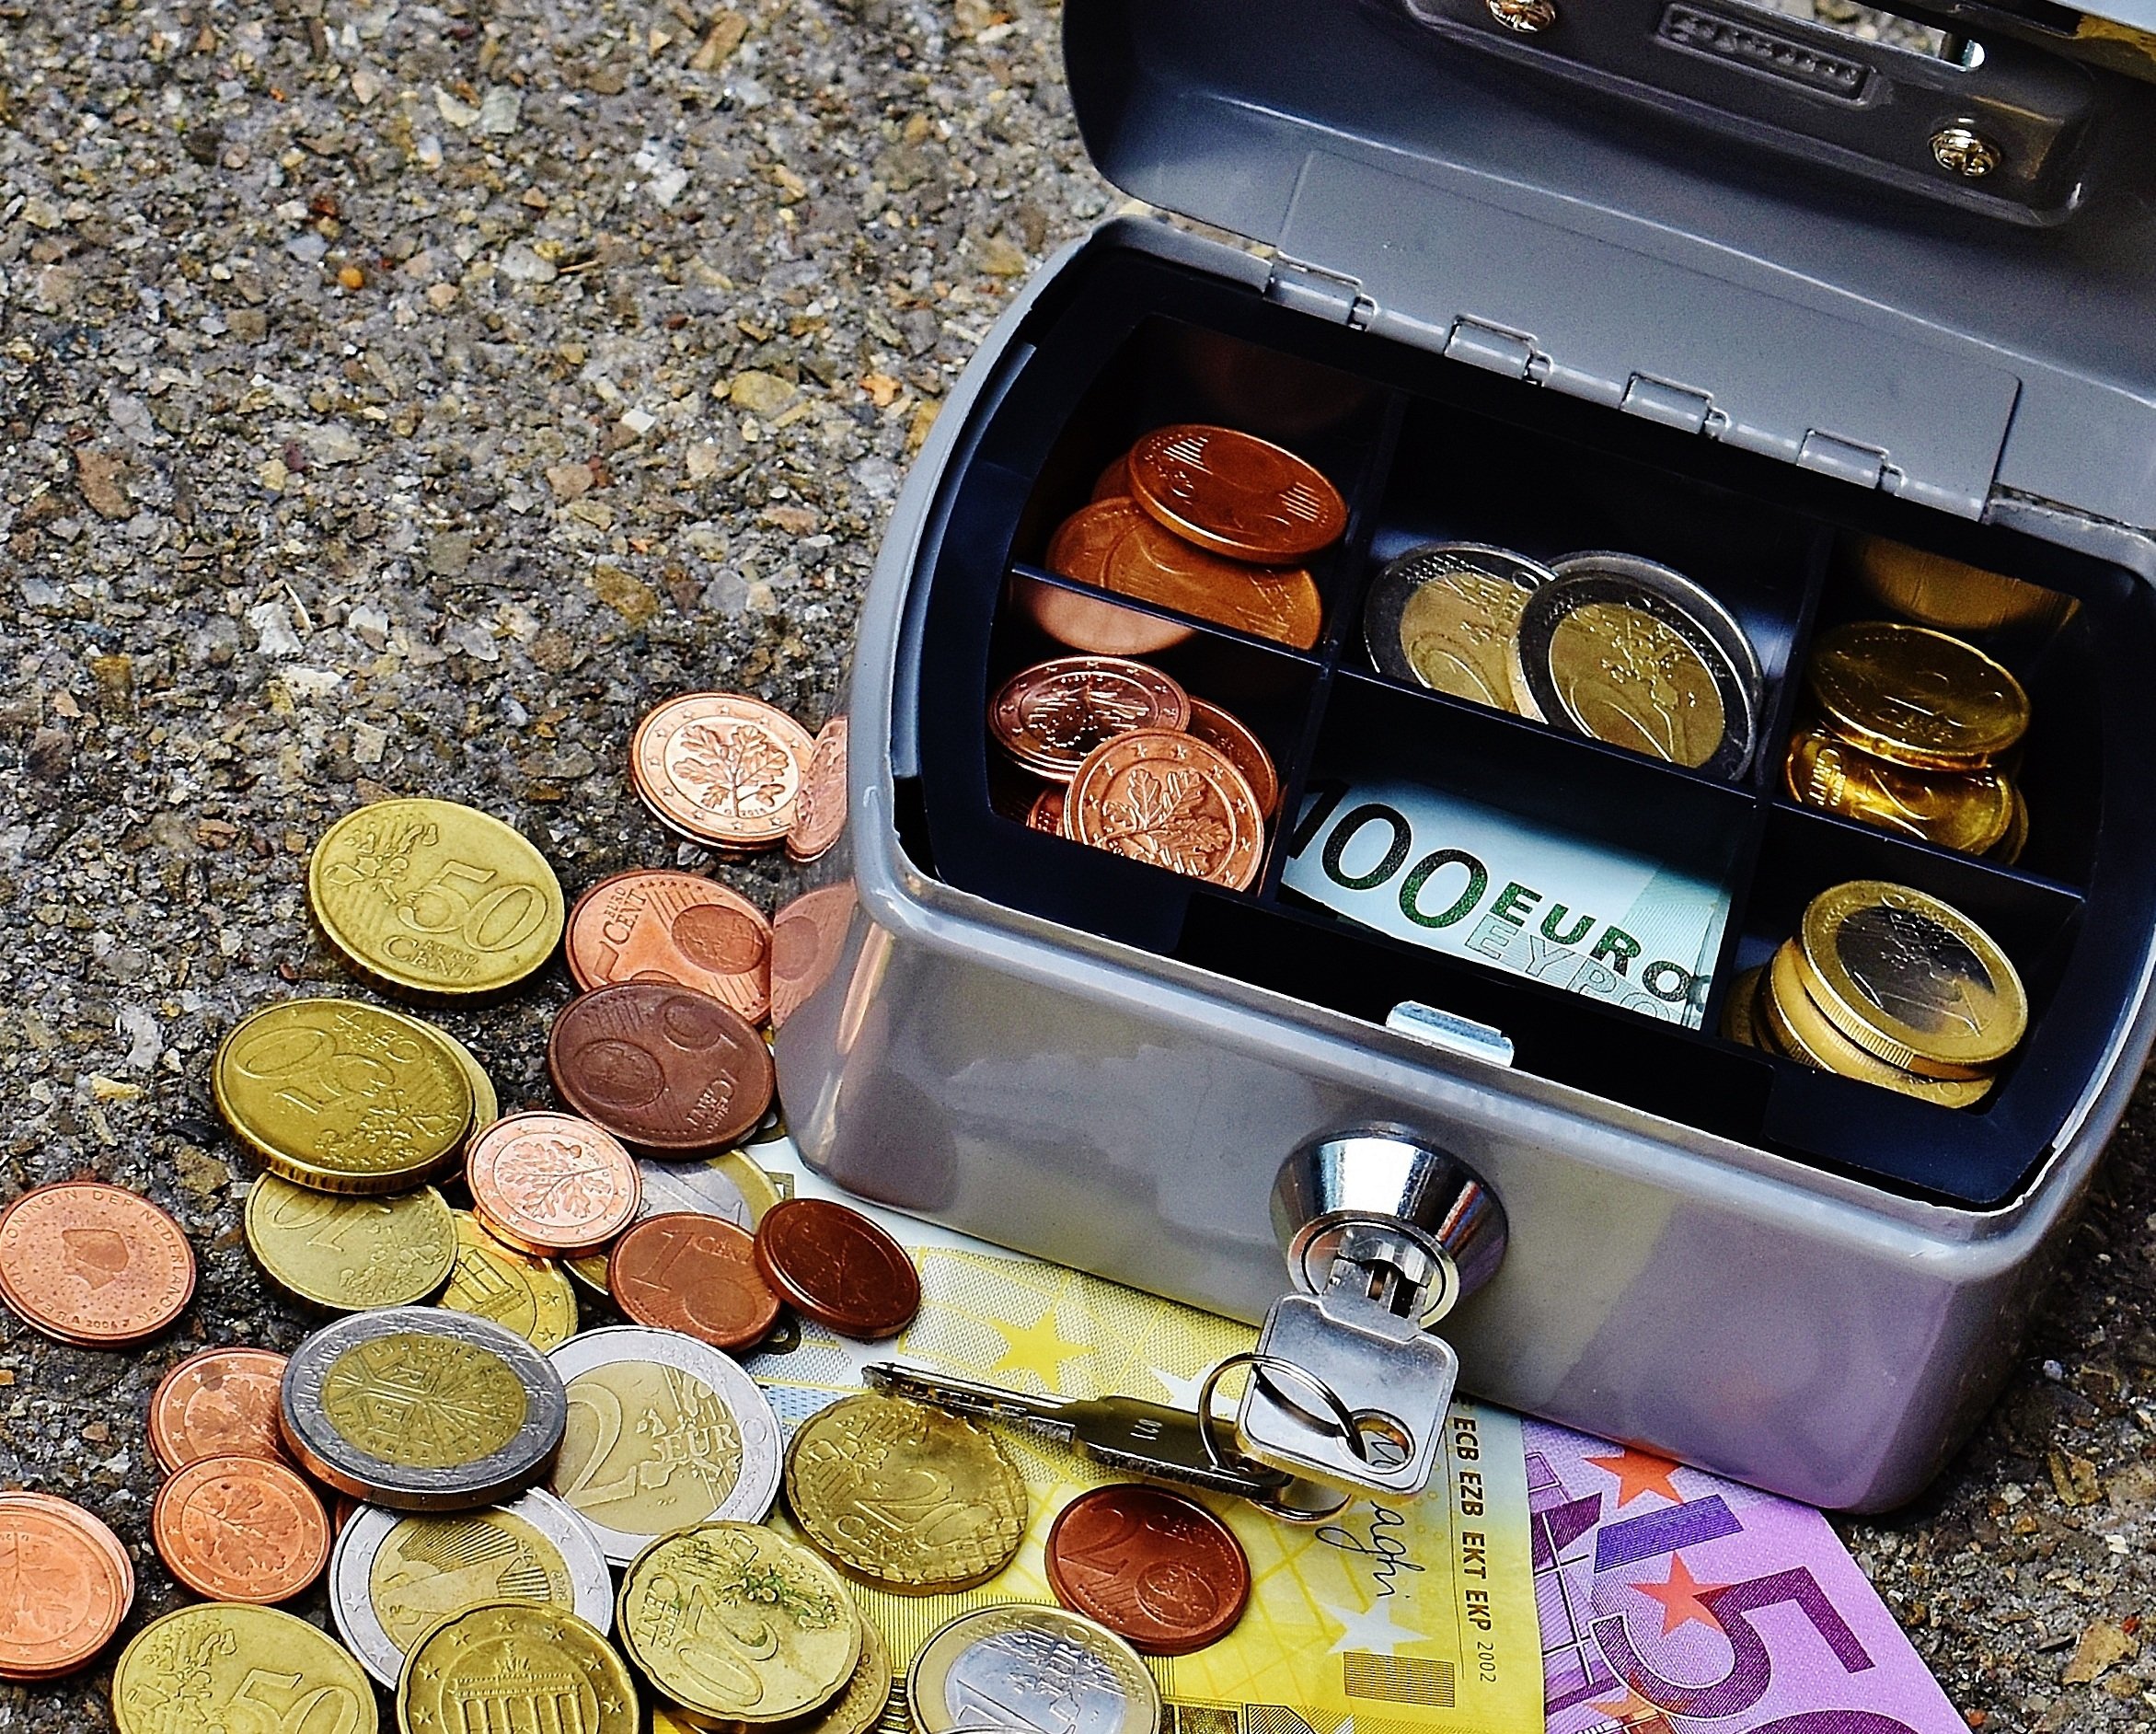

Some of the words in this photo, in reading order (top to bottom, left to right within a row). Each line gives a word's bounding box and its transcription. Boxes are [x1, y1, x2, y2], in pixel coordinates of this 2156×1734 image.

[396, 859, 548, 952] 50
[603, 888, 648, 946] CENT
[604, 885, 627, 918] EURO
[1288, 780, 1490, 930] 100
[1489, 881, 1696, 1003] EURO
[382, 934, 477, 979] CENT
[4, 1189, 79, 1251] KONINGIN
[92, 1190, 133, 1208] DER
[4, 1261, 68, 1323] BEATRIX
[135, 1208, 188, 1324] NEDERLANDEN
[661, 1416, 768, 1463] EURO
[1452, 1416, 1480, 1462] ECB
[1459, 1471, 1484, 1517] EZB
[1058, 1502, 1143, 1578] 2
[1462, 1531, 1487, 1580] EKT
[640, 1571, 685, 1647] CENT
[1465, 1589, 1493, 1633] EKP
[672, 1583, 779, 1706] 20
[1476, 1640, 1497, 1684] 2002
